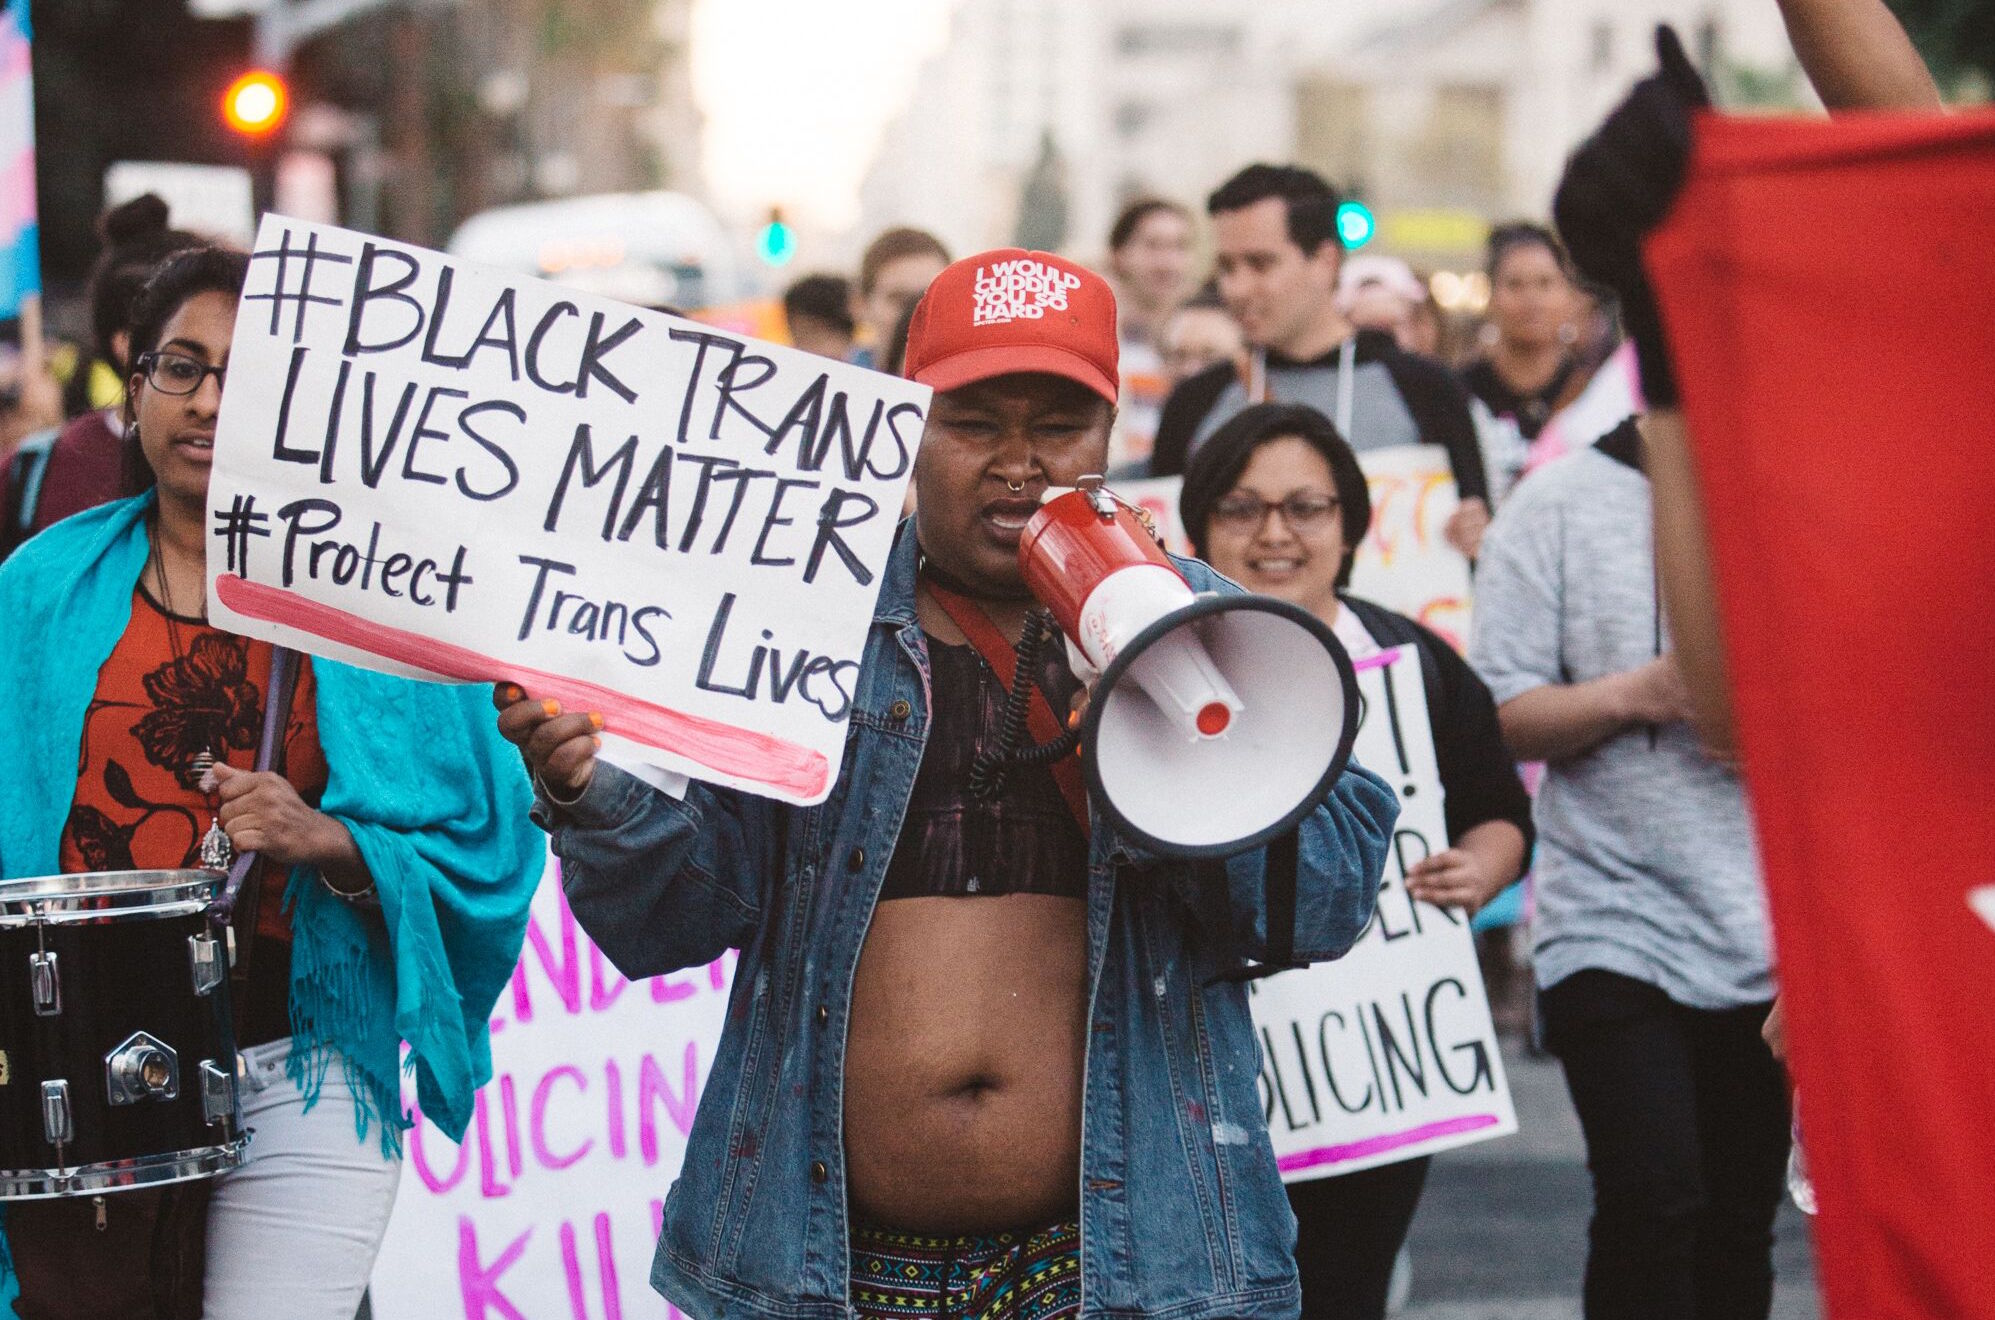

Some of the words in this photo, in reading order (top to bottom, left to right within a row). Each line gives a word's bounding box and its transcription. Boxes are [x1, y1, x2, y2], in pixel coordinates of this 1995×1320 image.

[972, 289, 1026, 306] YOU
[1034, 292, 1068, 311] SO
[973, 303, 1044, 322] HARD
[974, 275, 1067, 300] CUDDLE
[976, 267, 984, 282] I
[991, 259, 1081, 289] WOULD
[244, 229, 644, 404] #BLACK
[669, 327, 923, 481] TRANS
[272, 347, 527, 500] LIVES
[544, 424, 878, 586] MATTER
[213, 494, 473, 611] #Protect
[519, 555, 671, 667] Trans
[696, 593, 861, 723] Lives
[1261, 977, 1495, 1130] LICING
